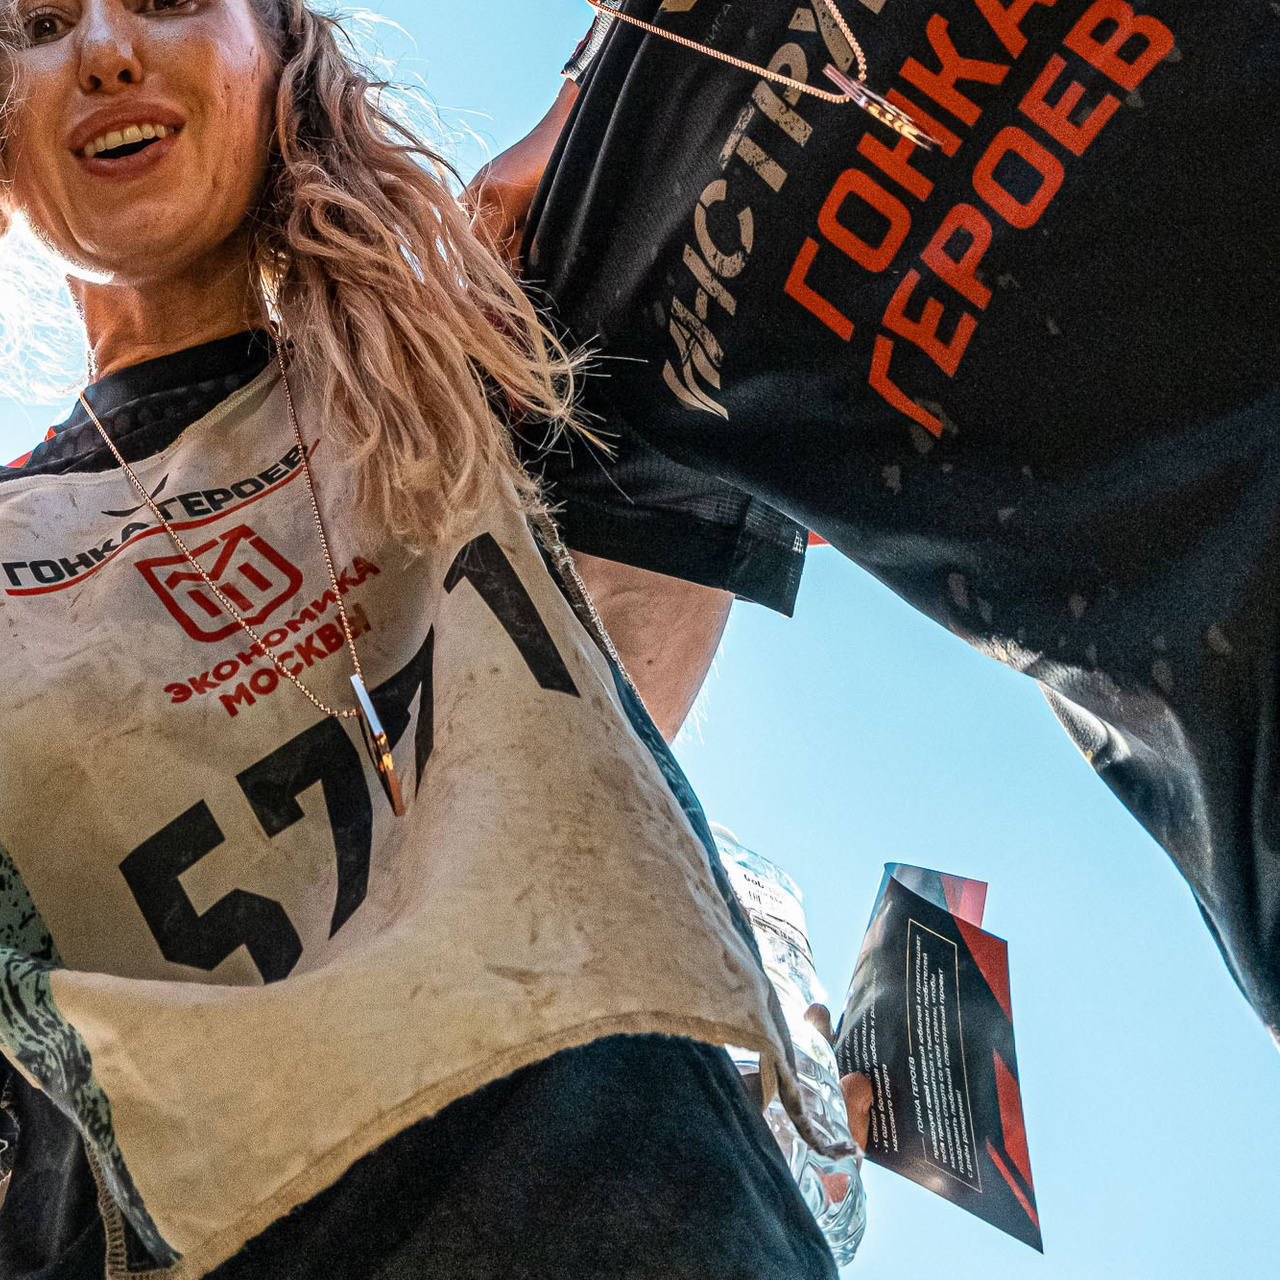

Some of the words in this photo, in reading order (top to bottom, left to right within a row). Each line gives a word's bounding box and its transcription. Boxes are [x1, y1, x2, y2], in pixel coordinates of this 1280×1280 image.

[1, 521, 151, 588] ГОНКА
[154, 443, 309, 523] ГЕРОЕВ
[163, 555, 382, 704] ЭКОНОМИКА
[218, 602, 373, 718] МОСКВЫ
[882, 1064, 892, 1098] спорта
[909, 1057, 920, 1098] ГЕРОЕВ
[915, 1100, 924, 1134] ГОНКА
